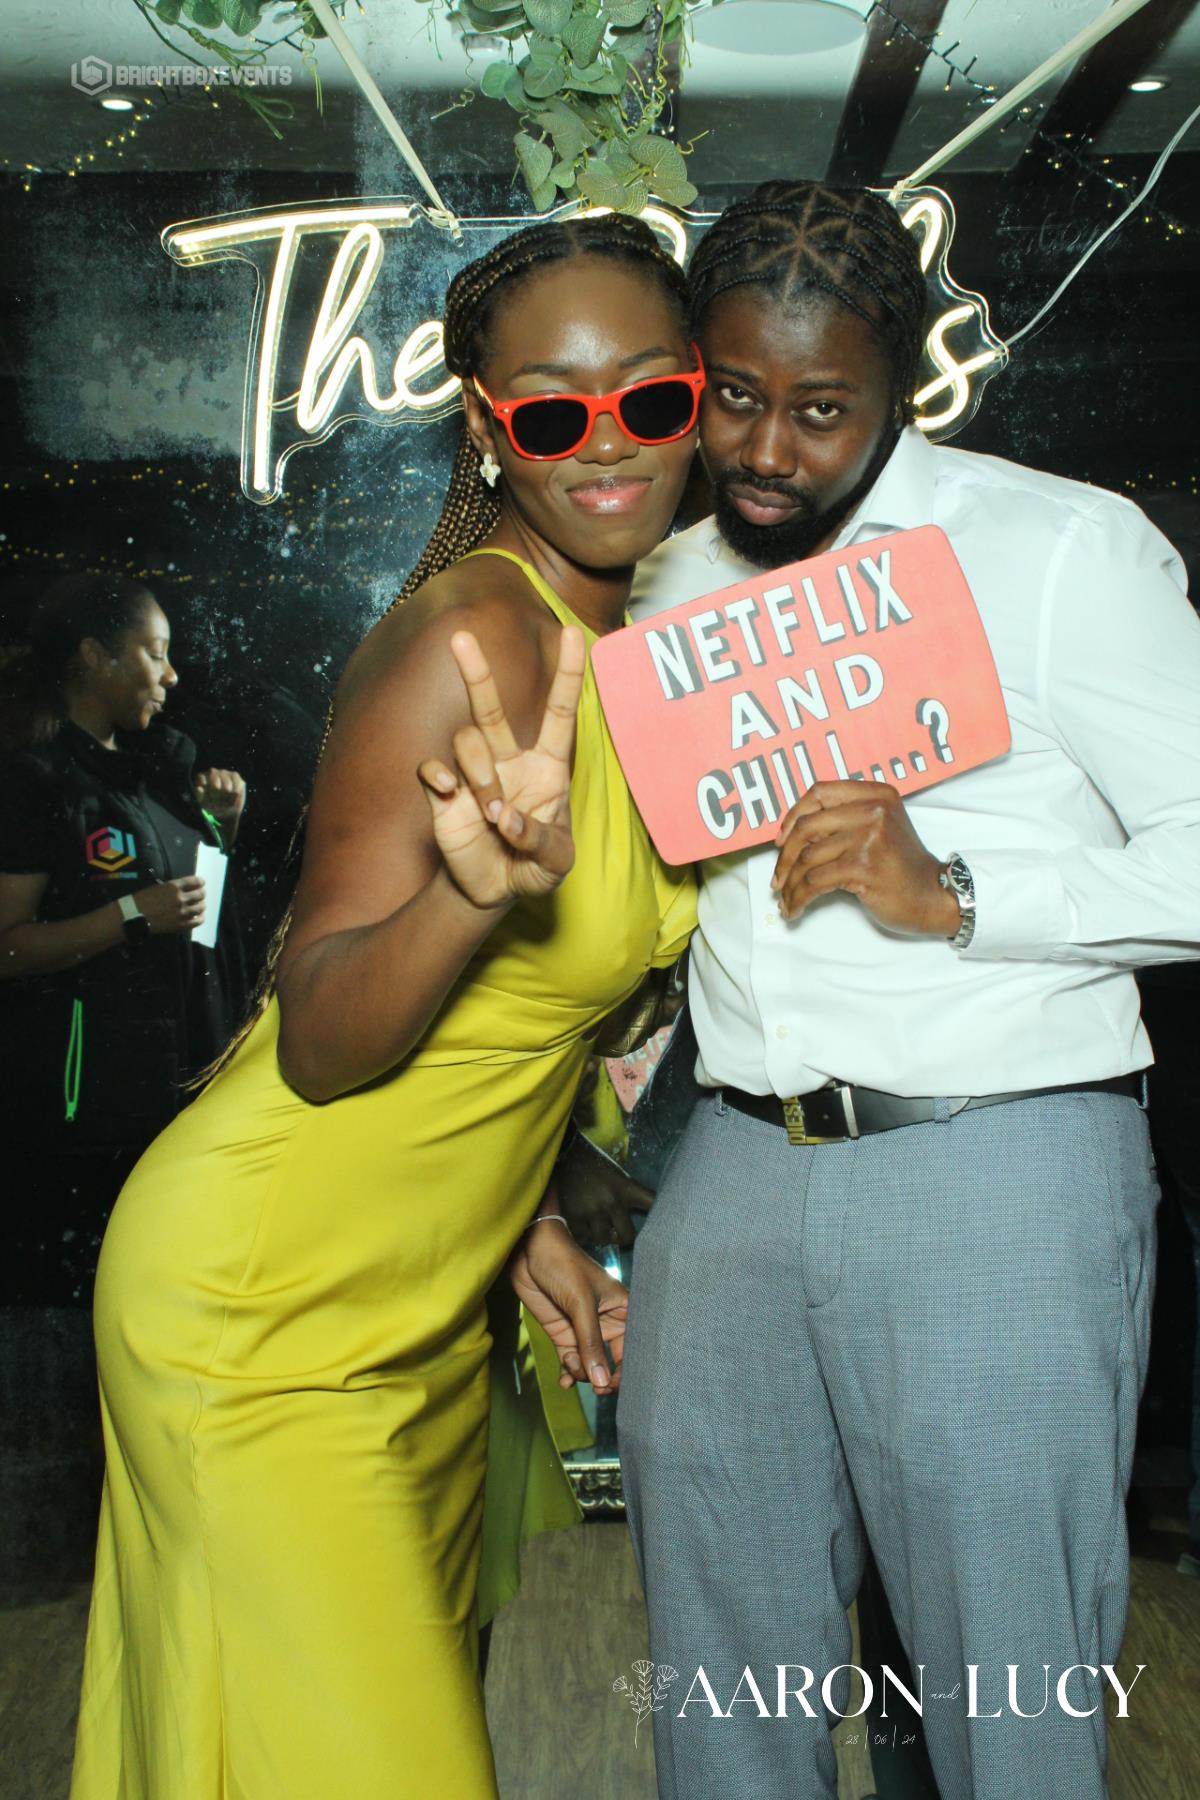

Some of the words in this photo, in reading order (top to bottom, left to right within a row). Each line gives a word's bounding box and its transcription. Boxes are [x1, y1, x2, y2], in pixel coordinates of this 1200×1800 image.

[172, 206, 463, 494] The
[644, 549, 914, 700] NETFLIX
[731, 653, 886, 750] AND
